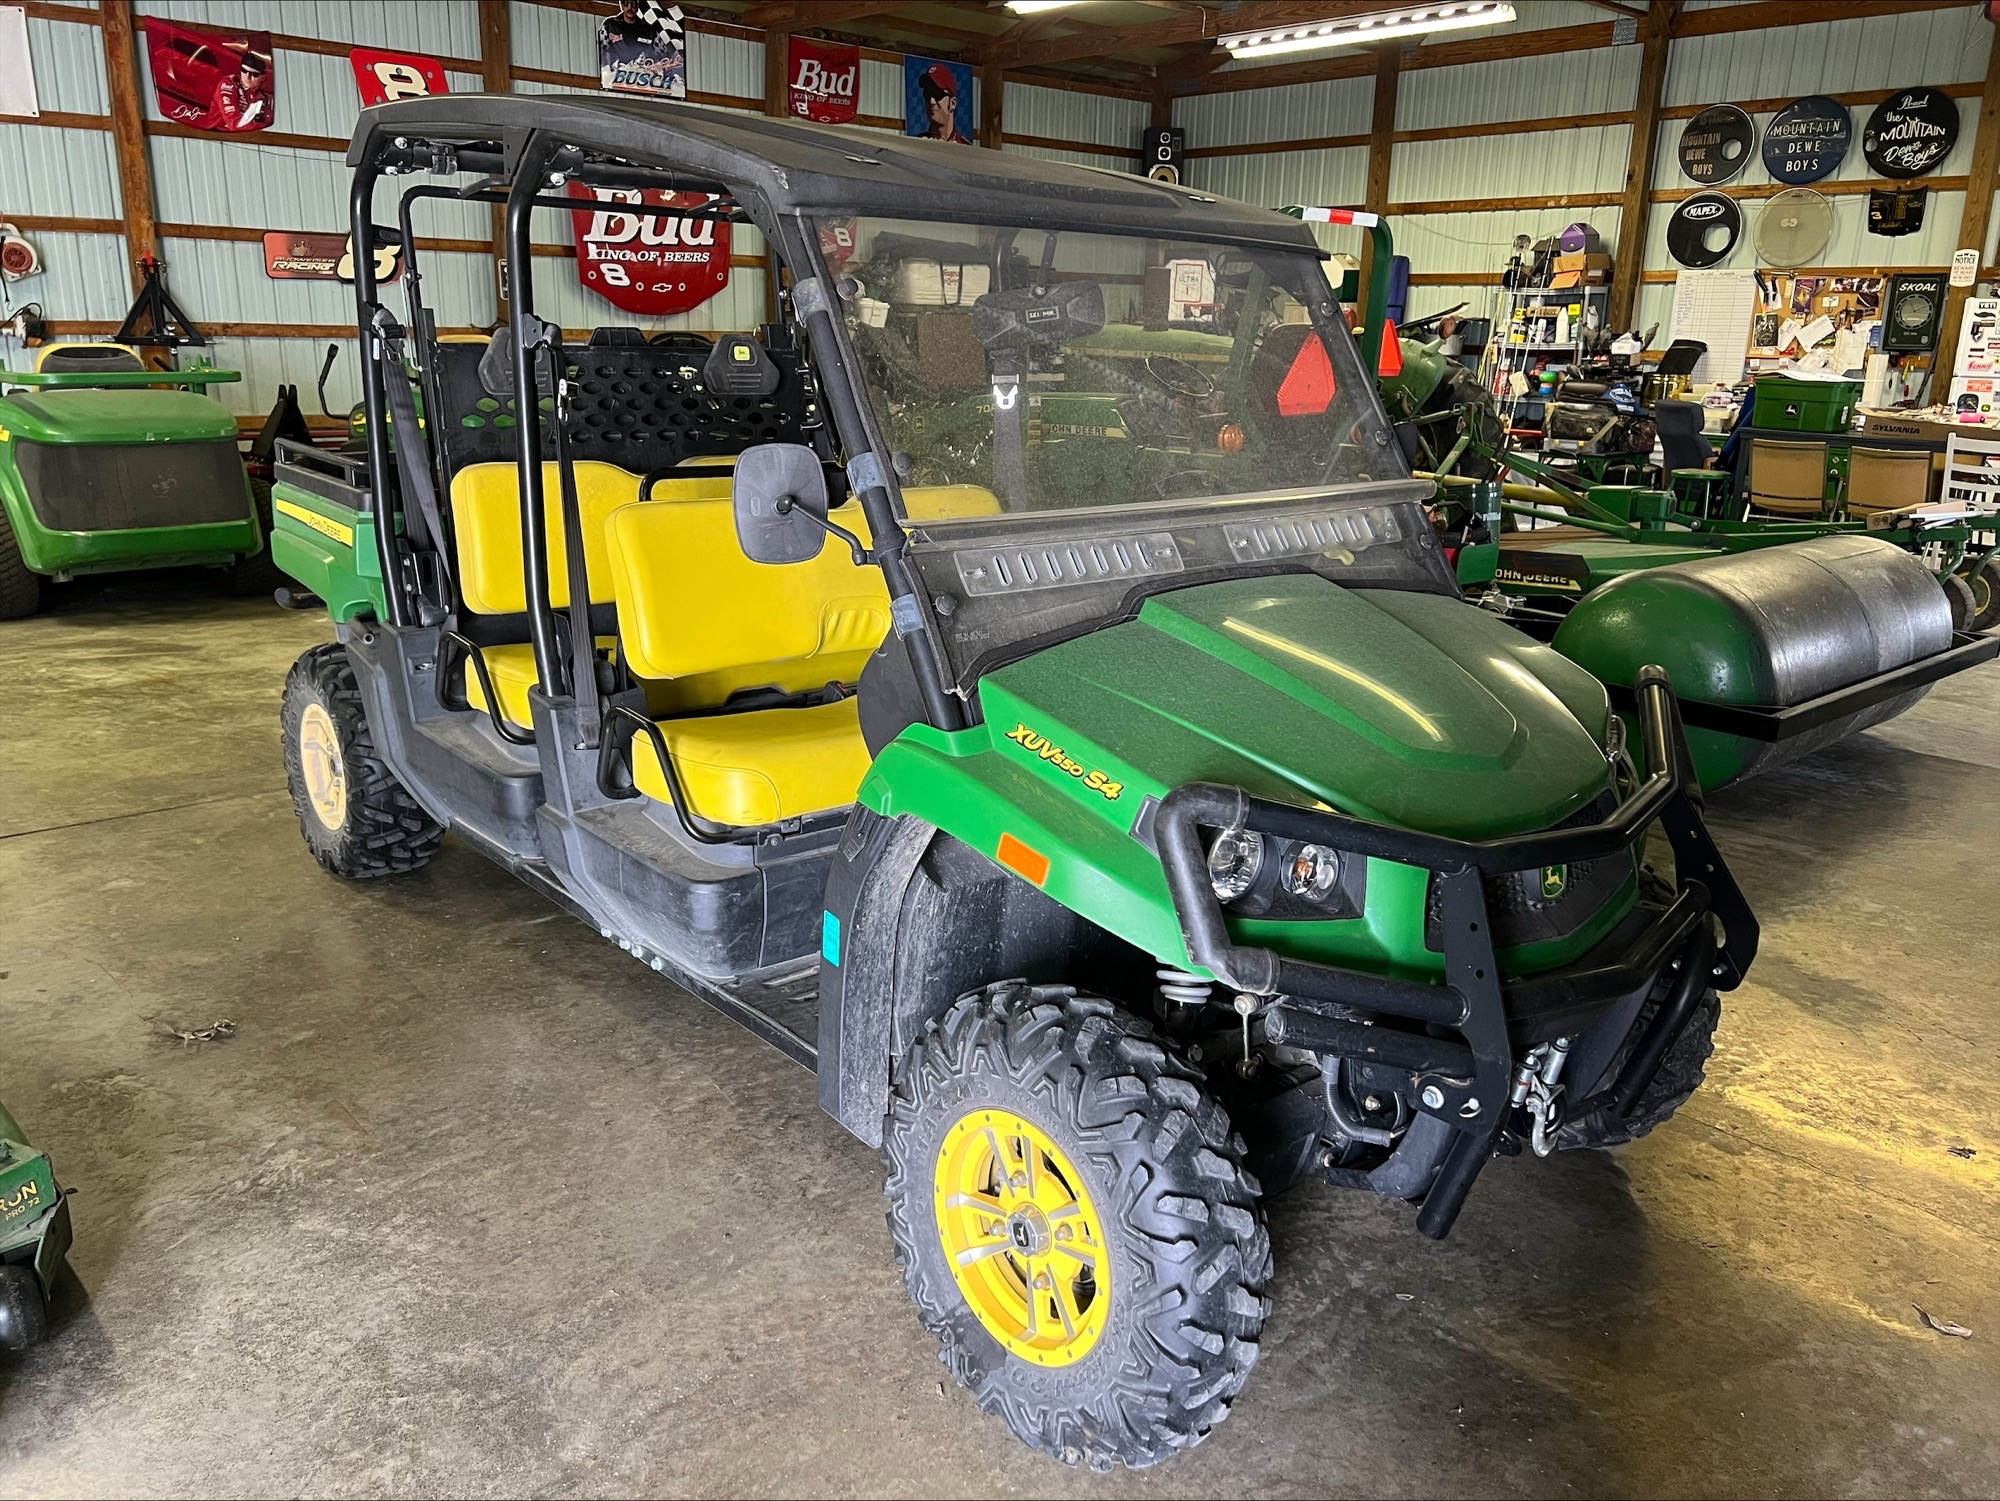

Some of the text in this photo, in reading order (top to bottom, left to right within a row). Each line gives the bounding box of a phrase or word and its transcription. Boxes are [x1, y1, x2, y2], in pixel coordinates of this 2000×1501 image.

[797, 59, 856, 96] Bud
[793, 93, 851, 106] KING OF BEERS
[1897, 94, 1929, 110] Pearl
[796, 102, 809, 115] 8
[1884, 111, 1904, 122] the
[1773, 120, 1840, 136] MOUNTAIN
[1880, 120, 1945, 141] MOUNTAIN
[1681, 132, 1721, 147] MOUNTAIN
[1686, 148, 1706, 160] DEWE
[1788, 141, 1821, 154] DEWE
[1901, 142, 1940, 170] Boys
[1692, 163, 1713, 175] BOYS
[1786, 159, 1818, 172] BOYS
[583, 187, 720, 245] Bud
[1689, 207, 1718, 216] MAPEX
[834, 228, 853, 247] 8
[587, 249, 711, 262] KING OF BEERS
[272, 261, 336, 271] RACING
[600, 263, 631, 287] 8
[1899, 282, 1937, 292] SKOAL
[1075, 426, 1107, 436] DEERE
[1872, 424, 1921, 435] SYLVANIA
[309, 513, 342, 541] JOHN DEERE
[1495, 568, 1521, 580] OHN
[1005, 722, 1124, 800] XUV550 S4
[5, 1196, 40, 1221] PRO 72
